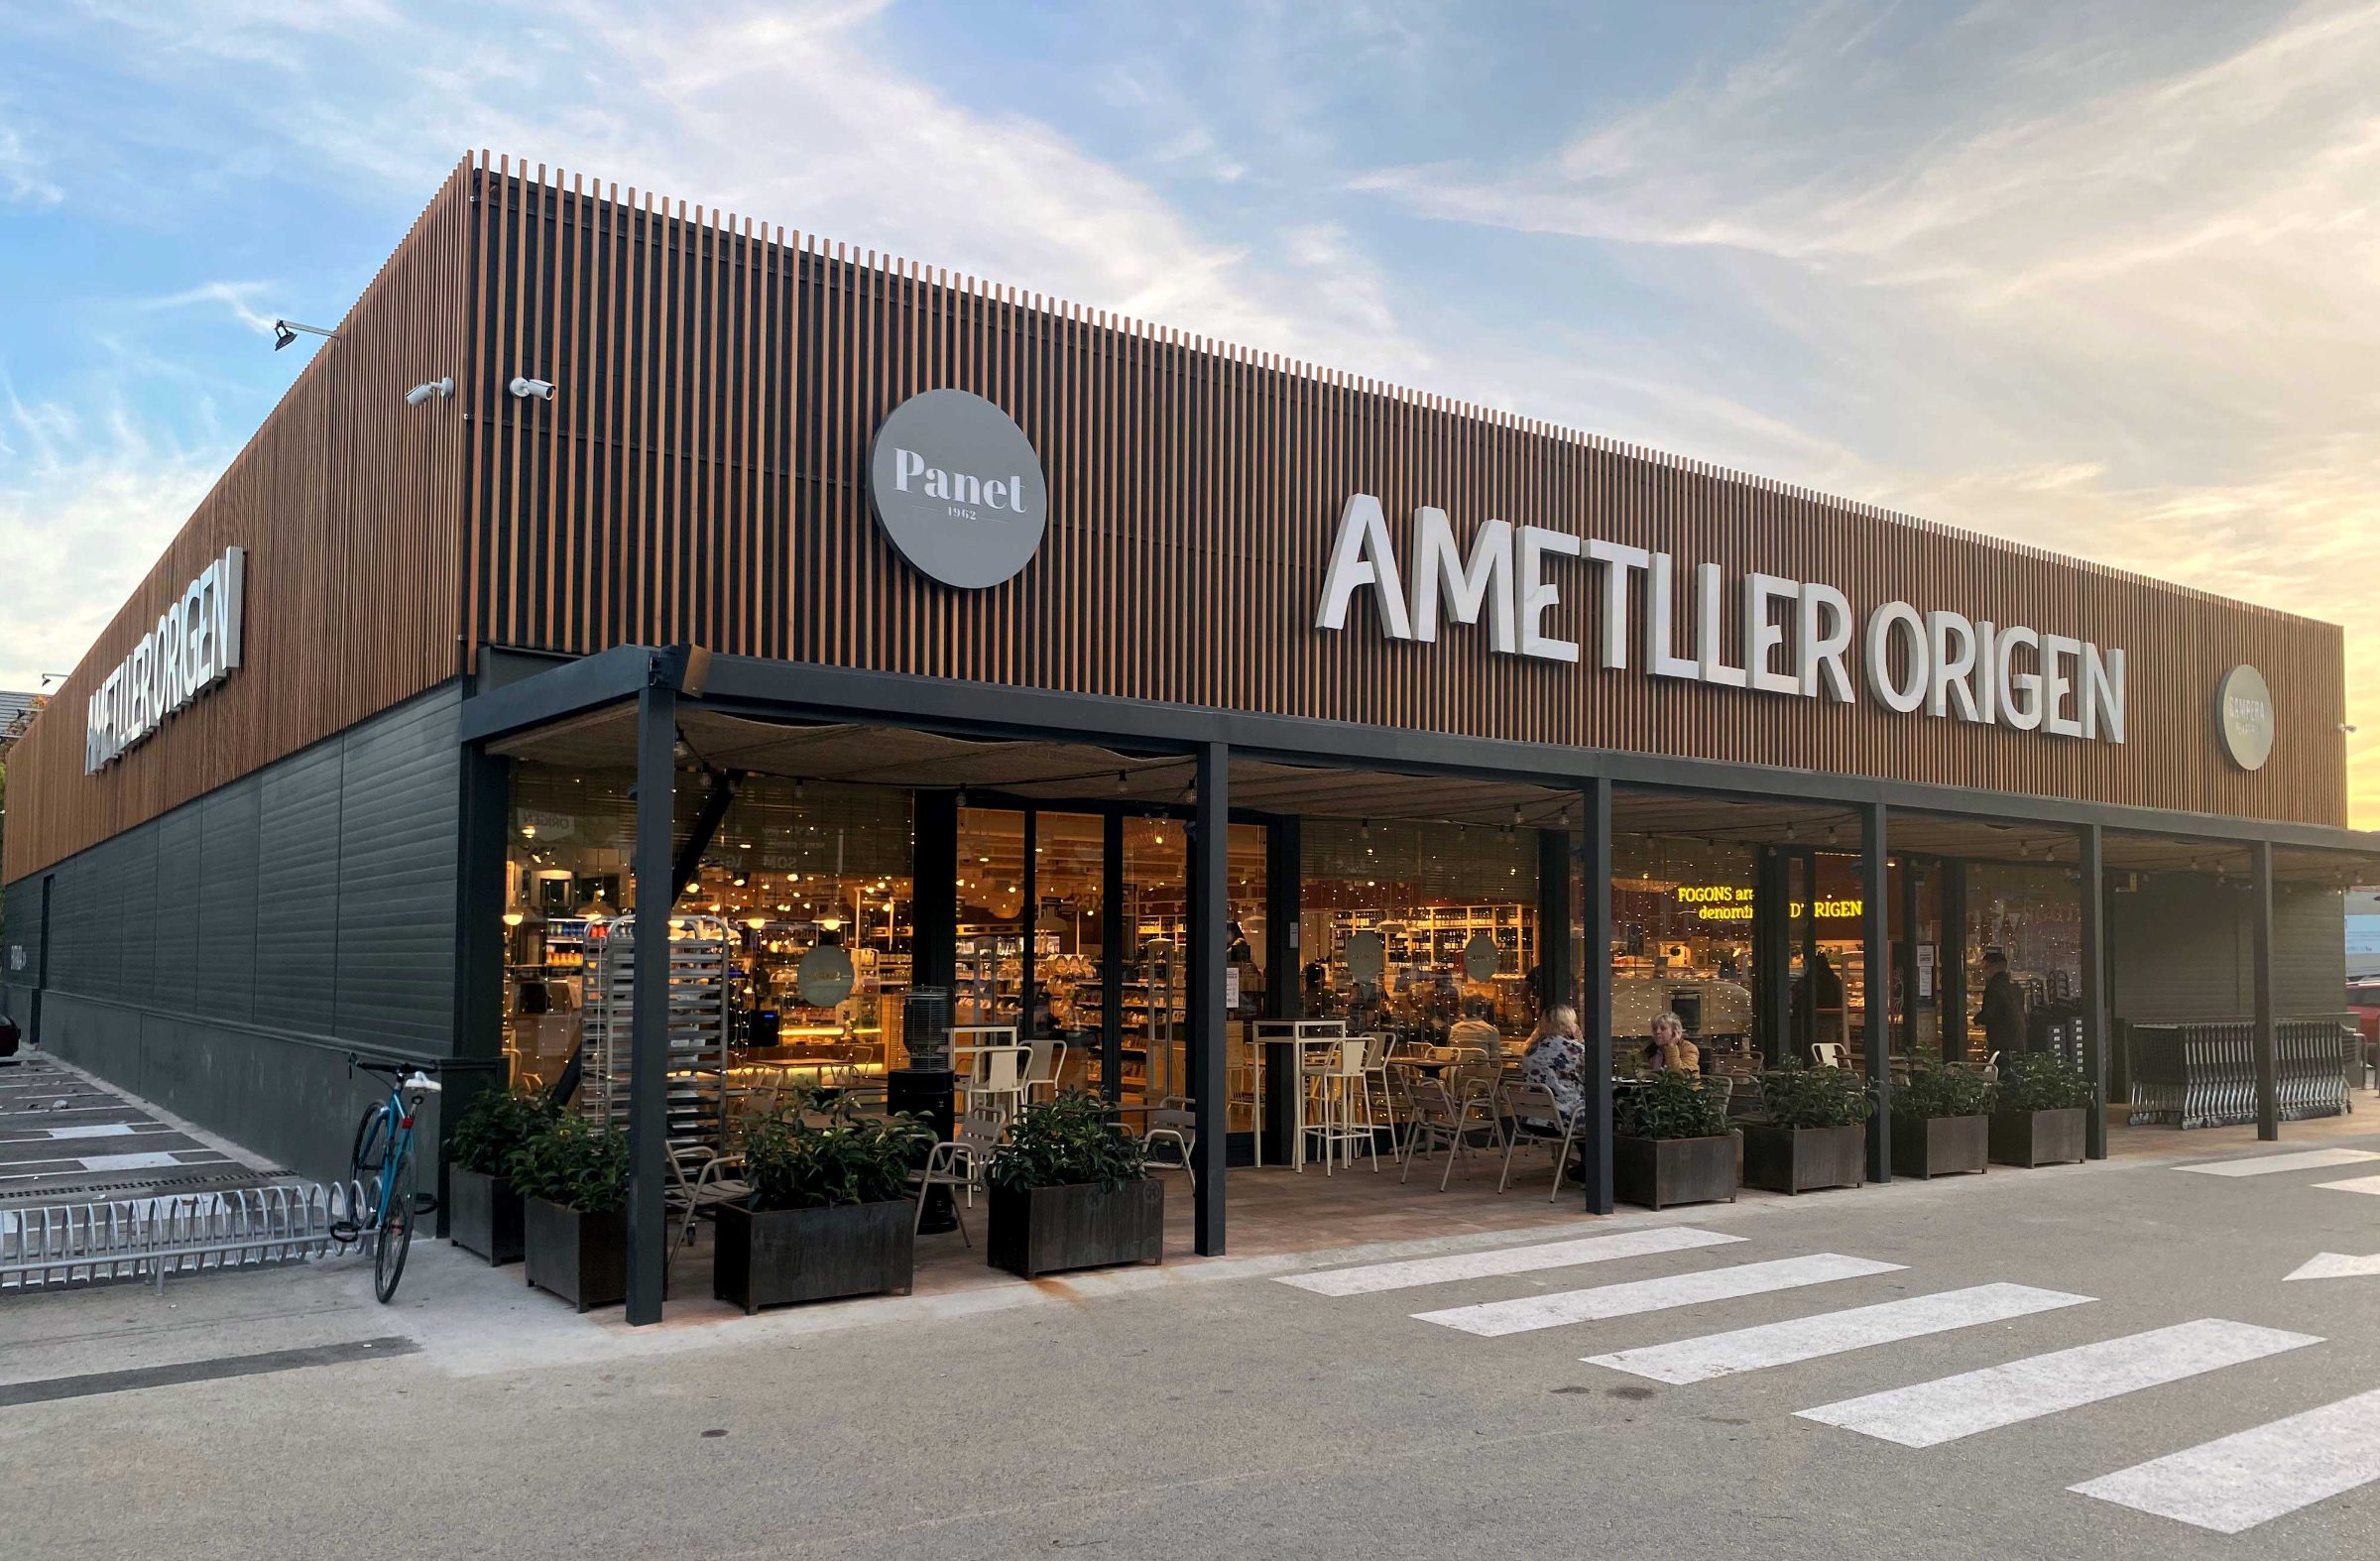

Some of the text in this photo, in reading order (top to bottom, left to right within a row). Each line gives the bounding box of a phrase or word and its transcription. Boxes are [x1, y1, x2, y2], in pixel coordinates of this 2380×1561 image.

[893, 448, 1029, 514] Panet
[947, 507, 977, 521] 1962
[154, 546, 244, 720] ORIGEN
[1315, 493, 2124, 744] AMETLLER ORIGEN
[1678, 887, 1732, 902] FOGONS
[1790, 901, 1863, 918] D'RIGEN
